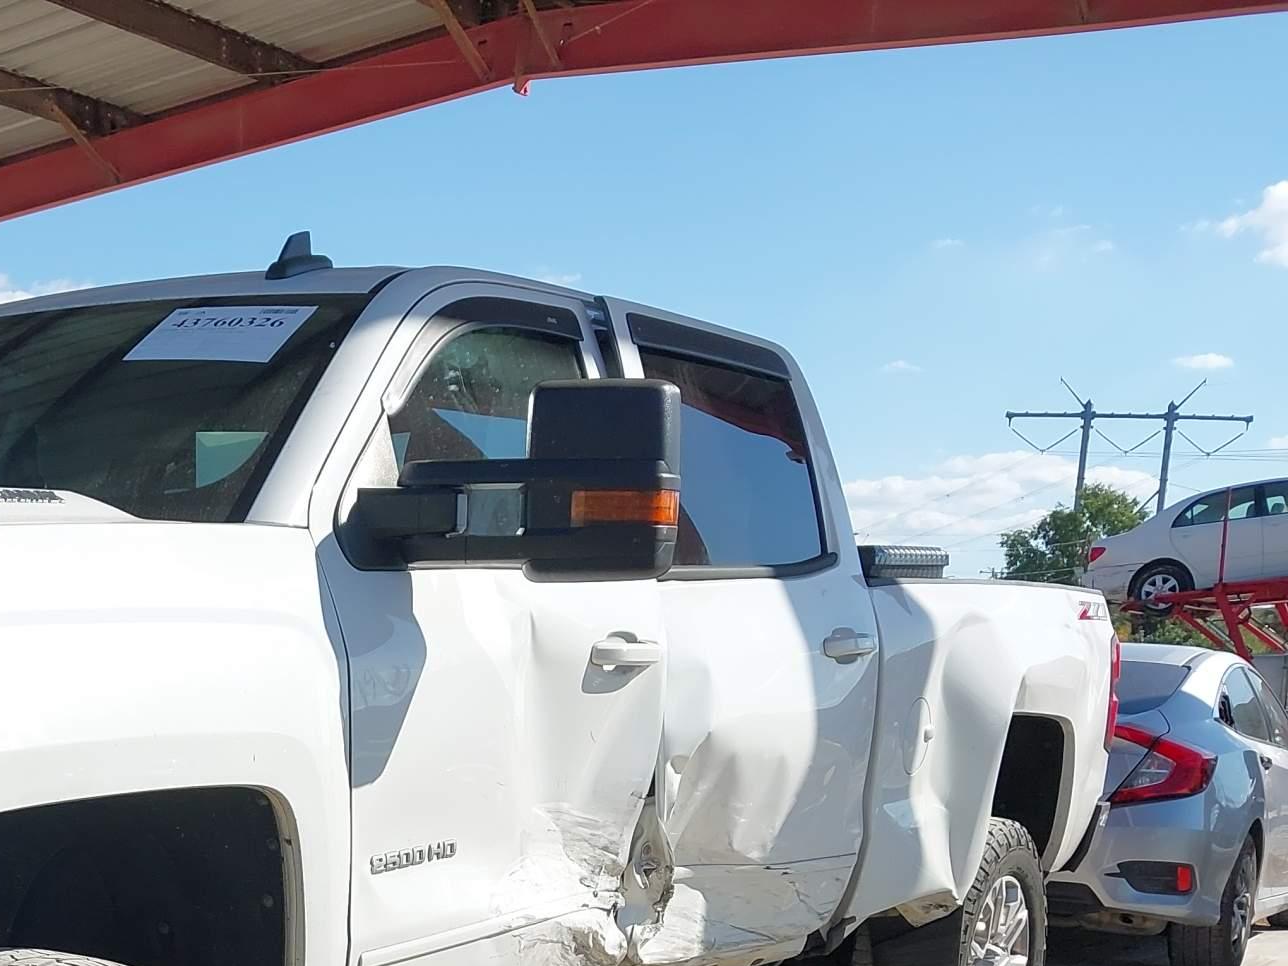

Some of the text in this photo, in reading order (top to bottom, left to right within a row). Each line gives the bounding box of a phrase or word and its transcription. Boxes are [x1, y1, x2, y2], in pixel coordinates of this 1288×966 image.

[172, 316, 285, 329] 43760326
[369, 838, 457, 875] 2500 HD
